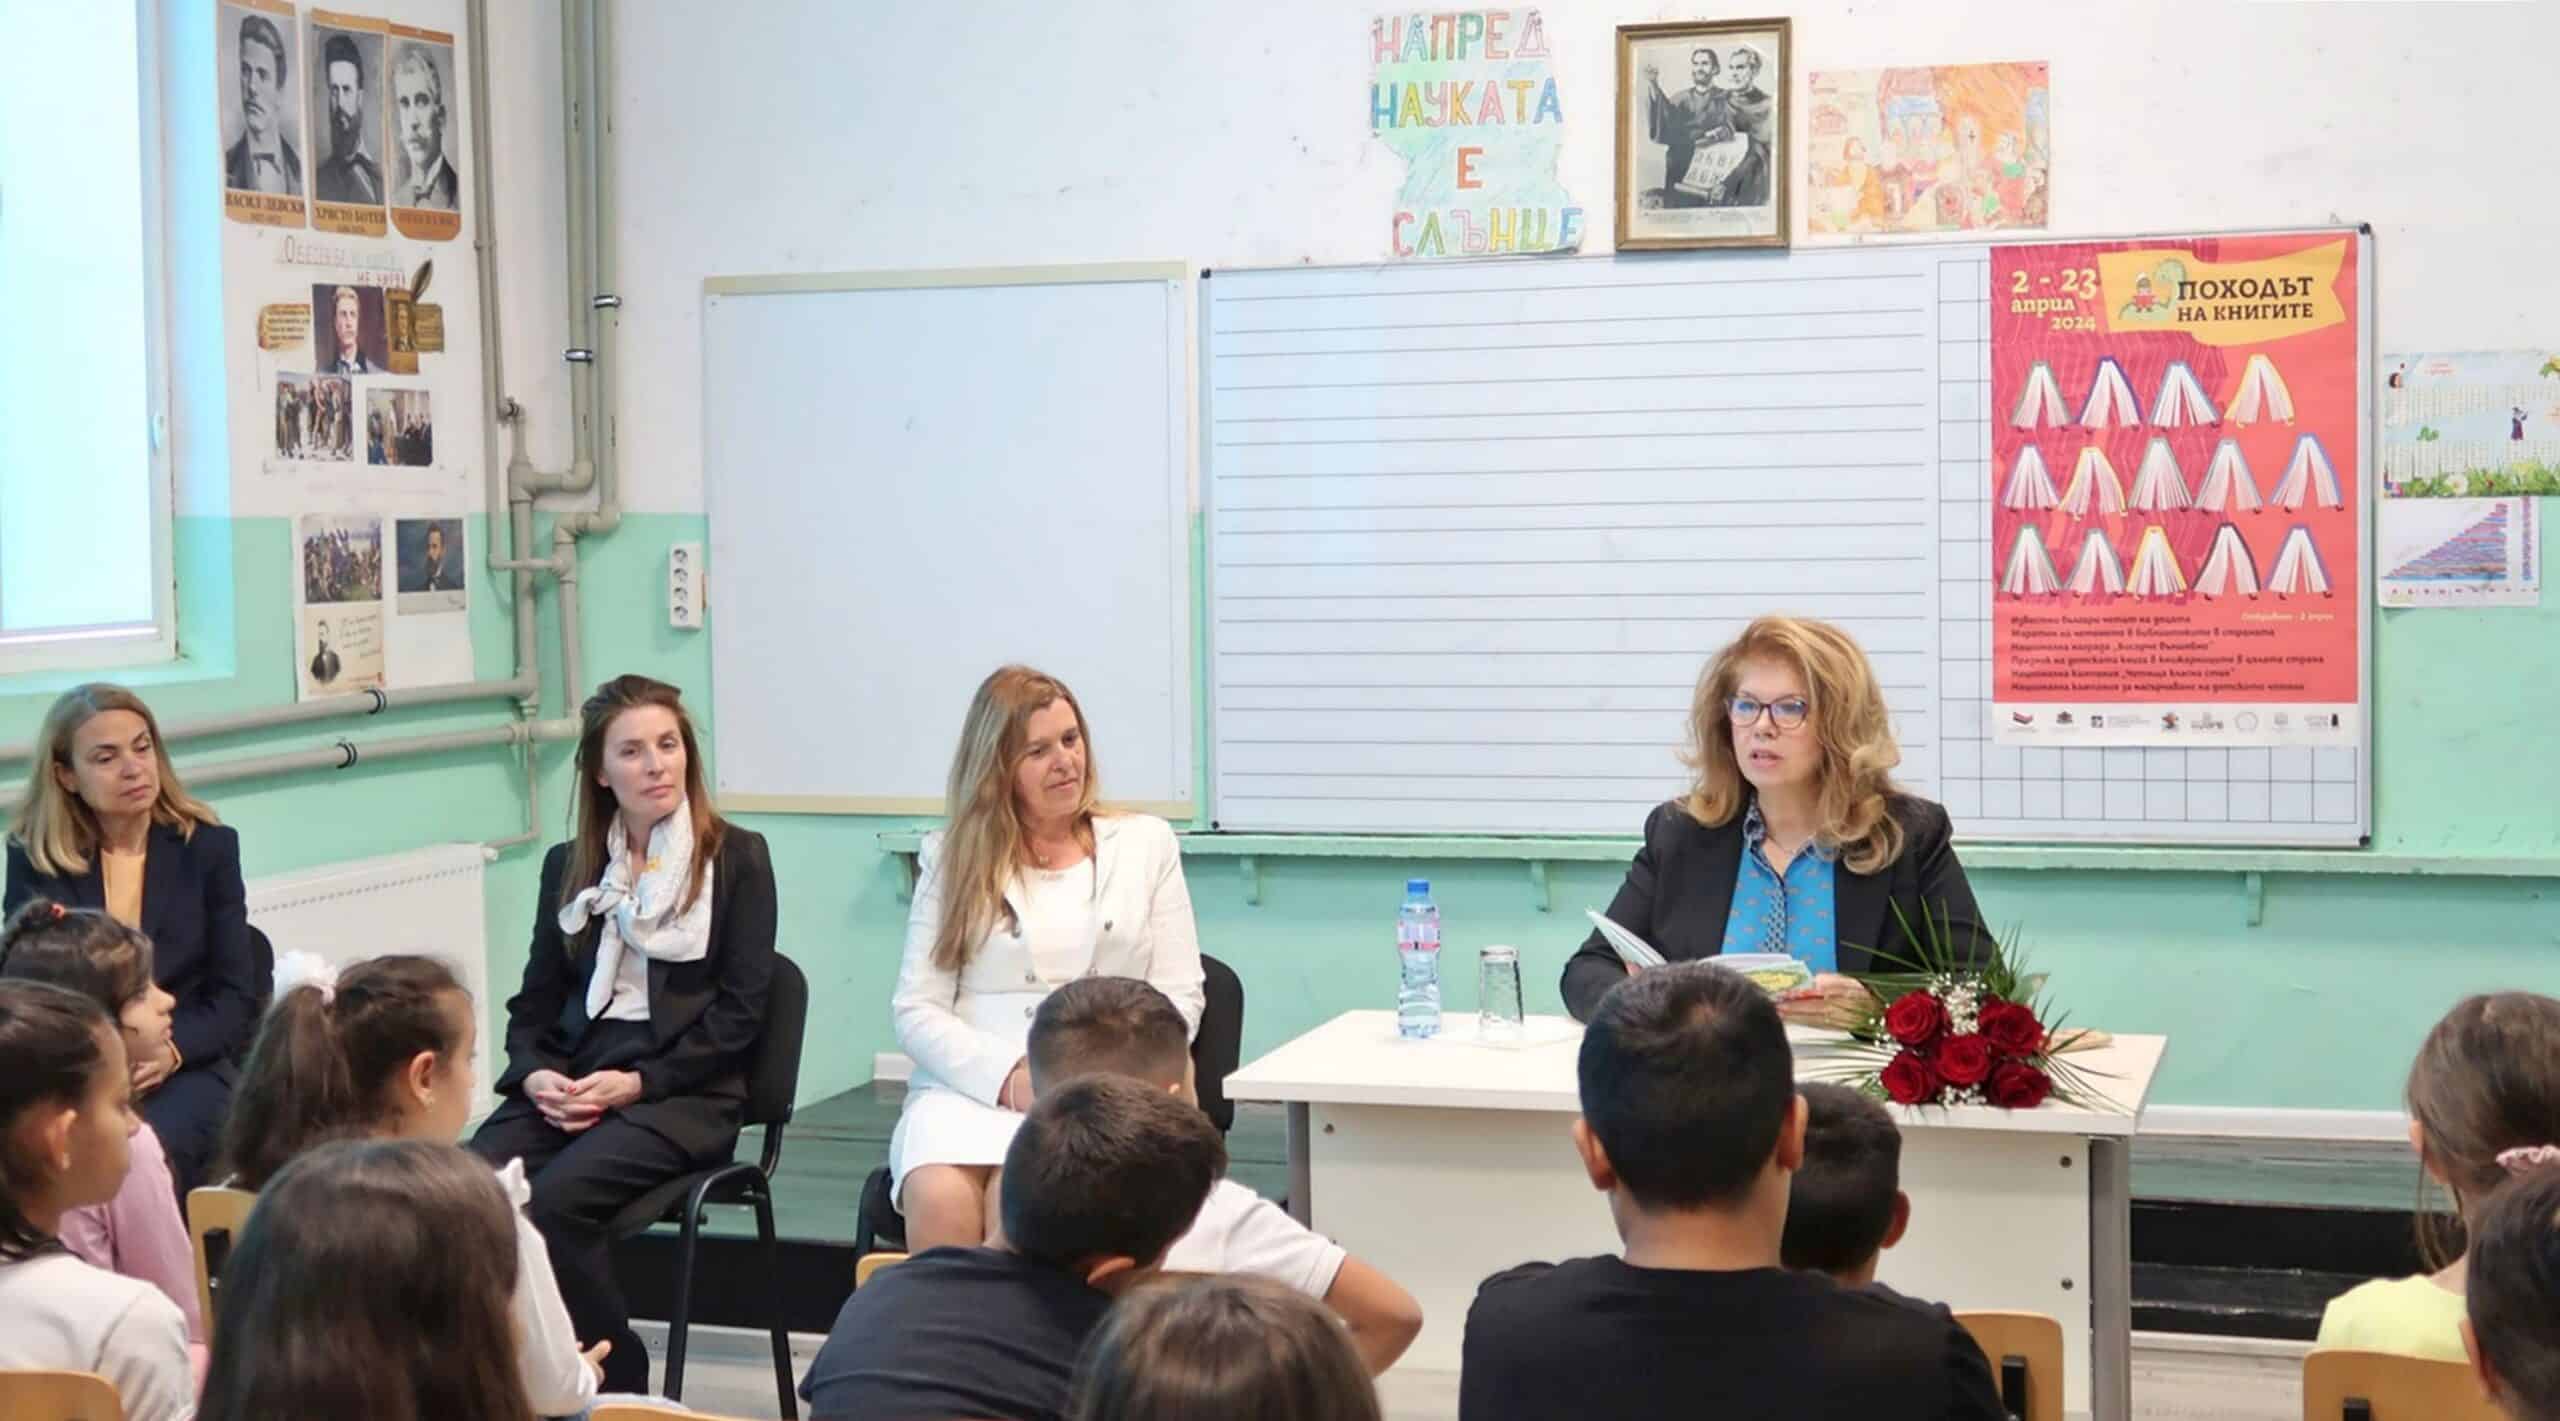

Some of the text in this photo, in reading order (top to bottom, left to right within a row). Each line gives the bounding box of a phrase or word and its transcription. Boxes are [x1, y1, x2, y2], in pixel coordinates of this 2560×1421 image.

[1373, 11, 1551, 64] НАПРЕД
[1370, 77, 1563, 129] НАУКАТА
[1456, 146, 1484, 190] Е
[1392, 207, 1585, 258] СЛЪНЦЕ
[2011, 269, 2029, 294] 2
[2060, 267, 2098, 300] 23
[2177, 276, 2315, 302] ПОХОДЪТ
[2011, 298, 2075, 319] април
[2050, 315, 2097, 332] 2024
[2177, 302, 2314, 322] НА КНИГИТЕ
